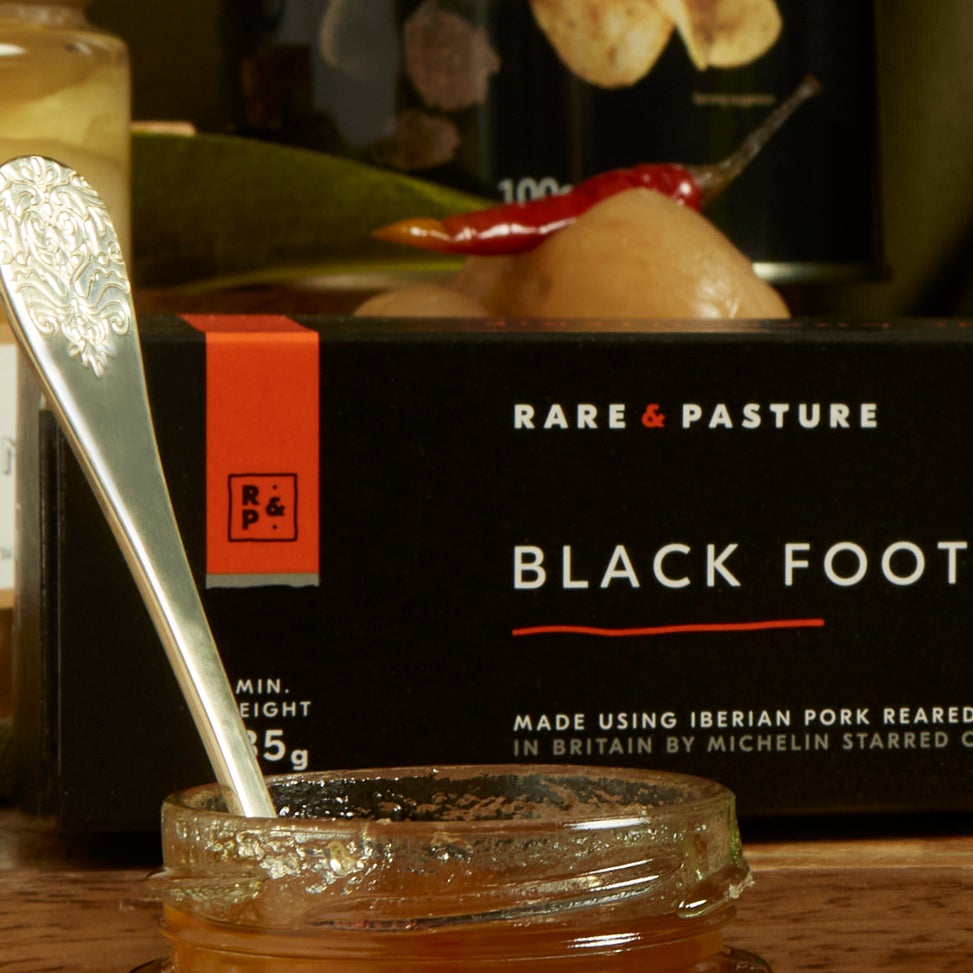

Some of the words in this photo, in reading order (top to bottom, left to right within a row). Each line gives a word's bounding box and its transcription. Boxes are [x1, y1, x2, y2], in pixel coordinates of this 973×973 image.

[498, 177, 575, 207] 100
[514, 403, 626, 429] RARE
[641, 403, 665, 428] &
[682, 403, 877, 429] PASTURE
[242, 484, 260, 506] R
[265, 496, 286, 517] &
[242, 508, 260, 530] P
[513, 543, 741, 590] BLACK
[784, 541, 968, 587] FOOT
[235, 678, 290, 695] MIN.
[240, 701, 312, 718] EIGHT
[513, 713, 585, 732] MADE
[599, 711, 677, 730] USING
[690, 710, 791, 728] IBERIAN
[804, 708, 870, 726] PORK
[514, 739, 538, 757] IN
[553, 737, 652, 756] BRITAIN
[666, 736, 695, 754] BY
[707, 733, 829, 752] MICHELIN
[842, 731, 949, 750] STARRED
